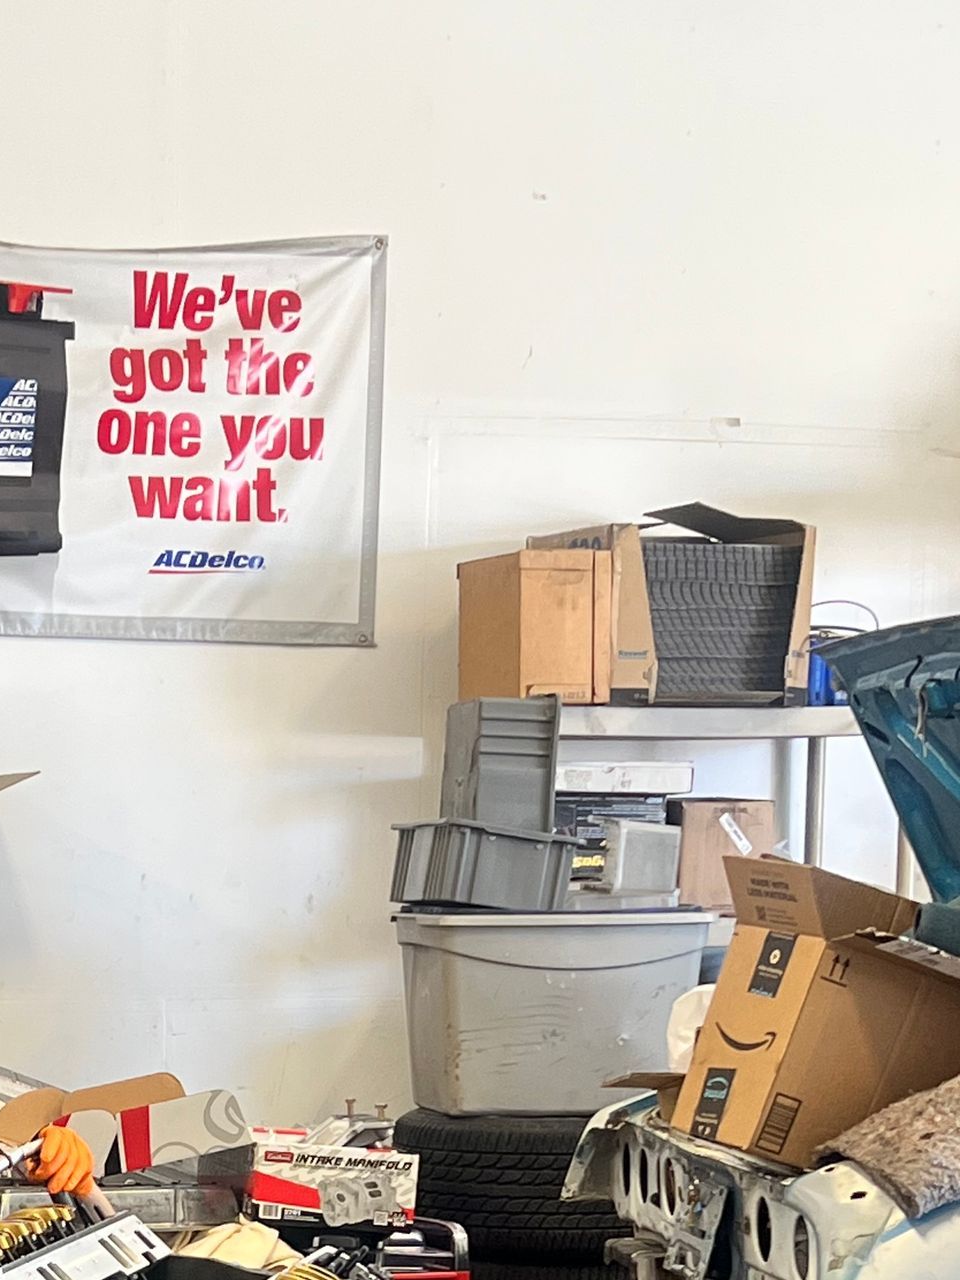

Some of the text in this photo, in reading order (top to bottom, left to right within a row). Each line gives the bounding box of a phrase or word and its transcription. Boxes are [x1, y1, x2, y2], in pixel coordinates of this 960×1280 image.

[133, 270, 302, 333] We've
[109, 337, 316, 404] got the
[1, 396, 37, 407] ACD
[96, 408, 325, 472] one you
[128, 467, 289, 523] want.
[153, 550, 266, 569] ACDelco
[295, 1153, 343, 1168] INTAKE
[345, 1157, 413, 1172] MANIFOLD
